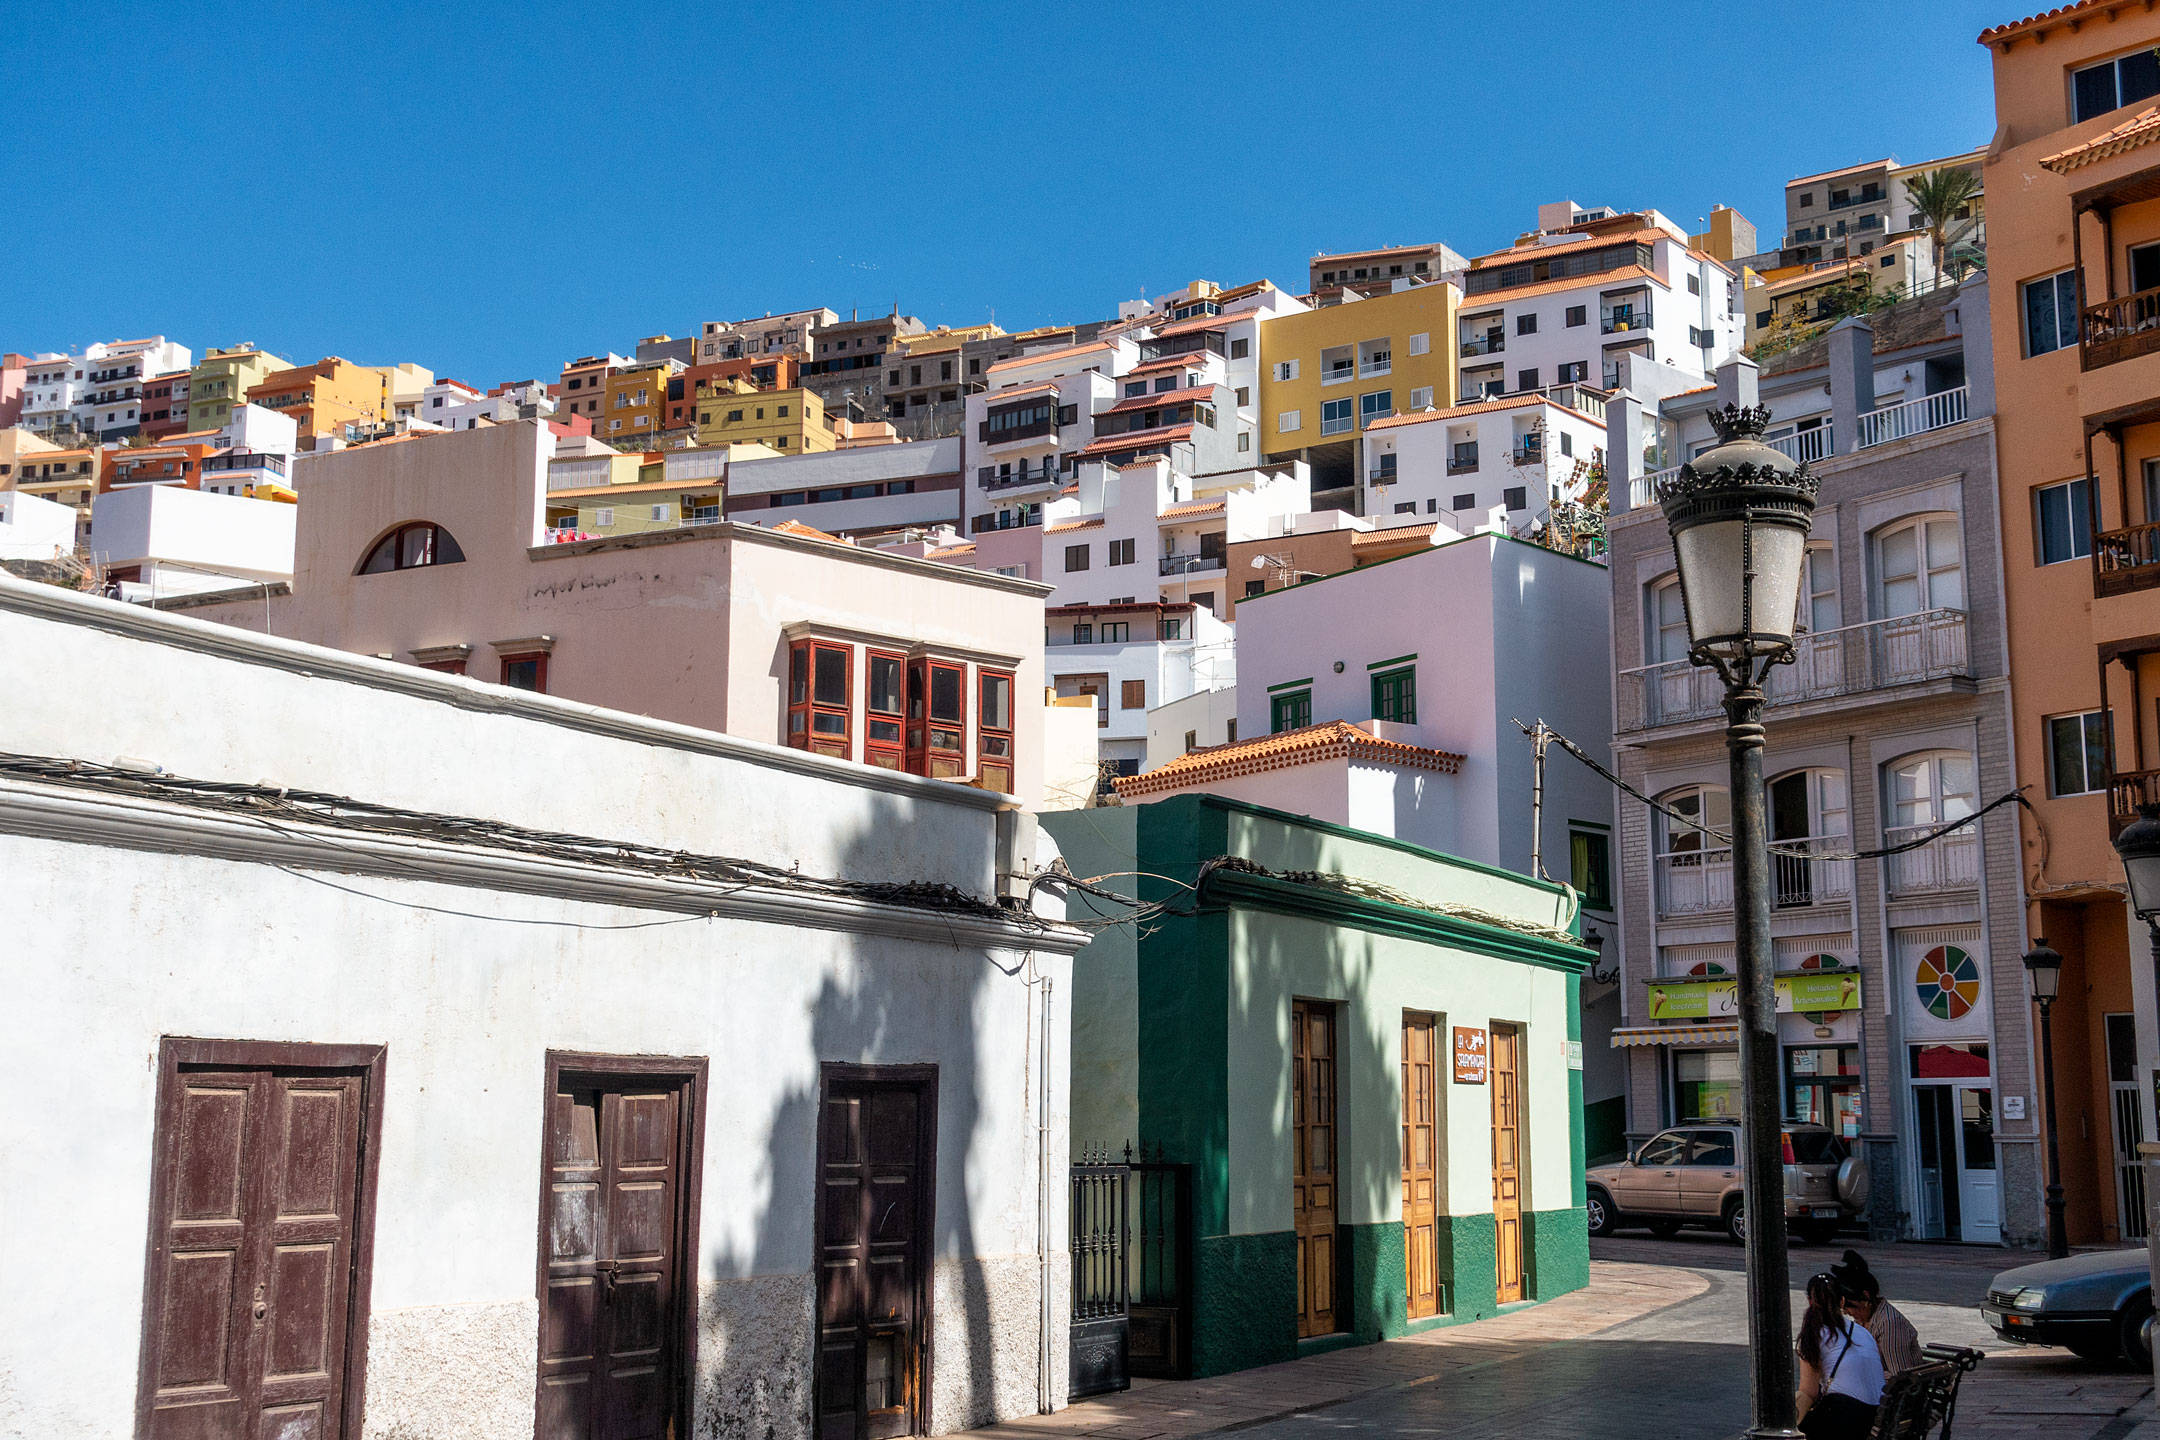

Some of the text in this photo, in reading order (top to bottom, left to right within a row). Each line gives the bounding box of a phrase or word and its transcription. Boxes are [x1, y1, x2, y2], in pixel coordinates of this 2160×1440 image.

[1807, 984, 1838, 992] Helados
[1670, 992, 1706, 1000] Handmade
[1794, 995, 1839, 1004] Artesanales
